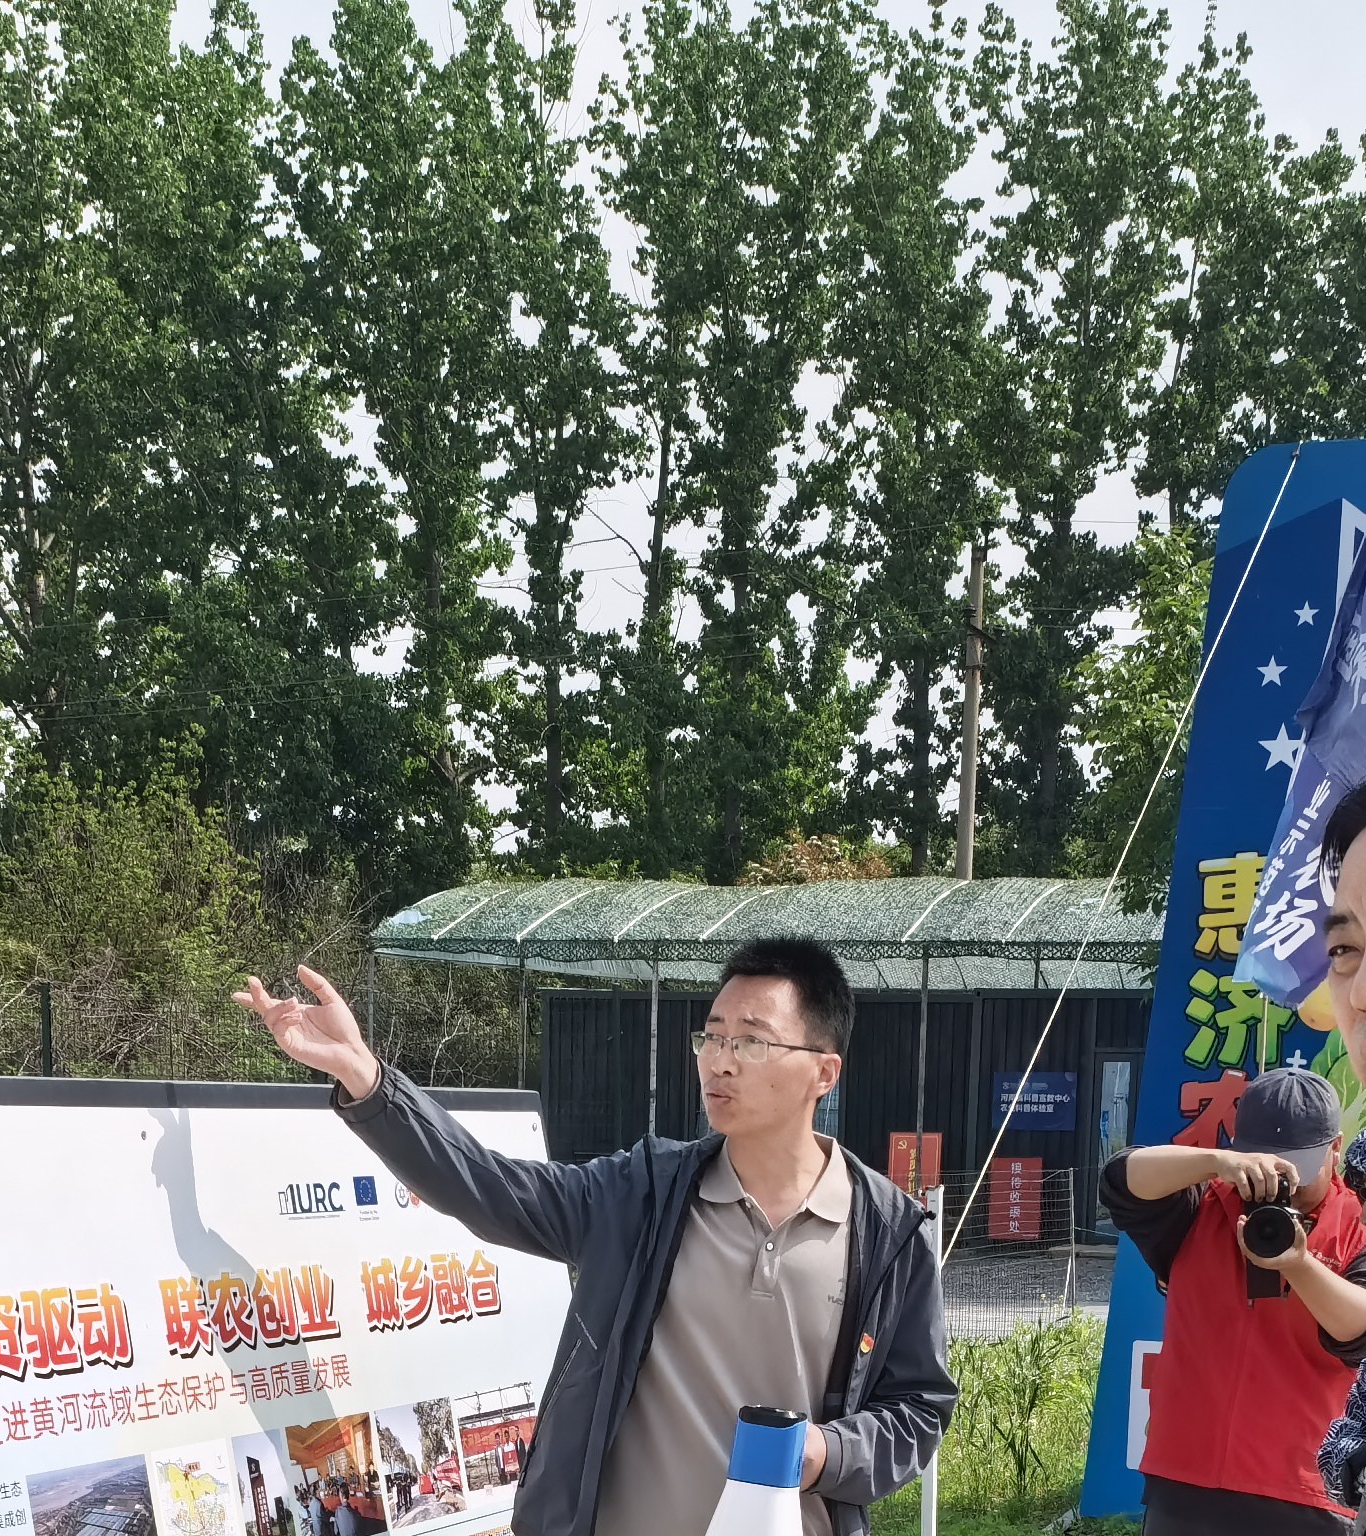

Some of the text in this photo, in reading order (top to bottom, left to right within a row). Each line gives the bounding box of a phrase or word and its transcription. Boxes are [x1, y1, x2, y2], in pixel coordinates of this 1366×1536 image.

[158, 1264, 340, 1358] 联农创业
[359, 1248, 503, 1333] 城乡融合
